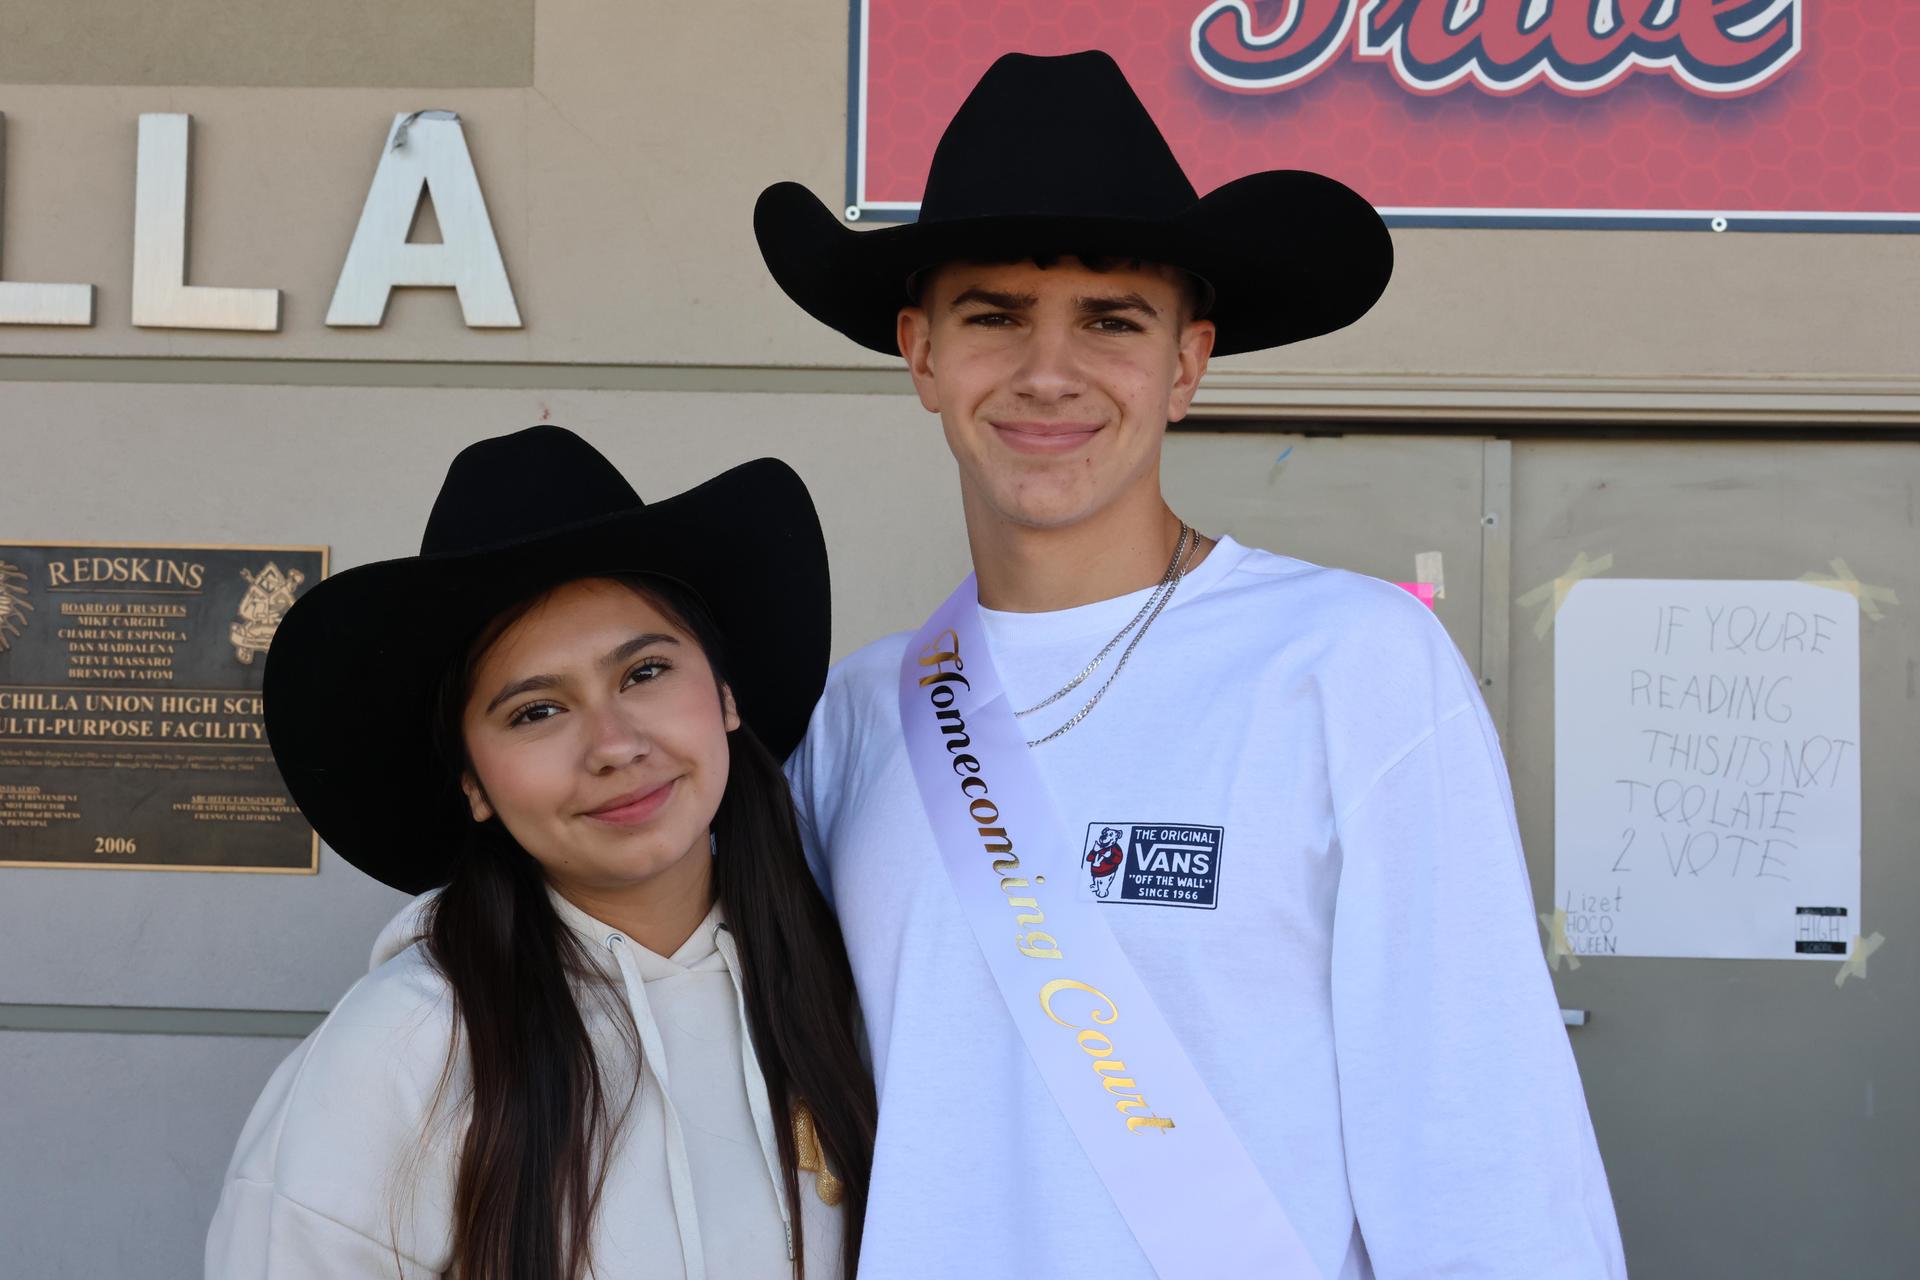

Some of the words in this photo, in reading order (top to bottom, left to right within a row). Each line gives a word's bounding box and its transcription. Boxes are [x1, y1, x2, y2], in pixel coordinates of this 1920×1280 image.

[48, 557, 205, 589] REDSKINS
[61, 603, 103, 615] BOARD
[106, 604, 121, 614] OF
[127, 604, 187, 616] TRUSTEES
[78, 616, 109, 626] MIKE
[113, 617, 167, 628] CARGILL
[1654, 605, 1691, 656] IF
[58, 629, 123, 639] CHARLENE
[127, 631, 187, 641] ESPINOLA
[69, 642, 94, 652] DAN
[71, 655, 109, 665] STEVE
[68, 669, 126, 679] BRENTON
[85, 695, 154, 712] UNION
[161, 697, 217, 714] HIGH
[1631, 669, 1793, 724] READING
[161, 720, 265, 739] FACILITY
[1136, 829, 1157, 840] THE
[1160, 830, 1215, 844] ORIGINAL
[94, 837, 137, 854] 2006
[1135, 843, 1213, 875] VANS
[1612, 828, 1636, 872] 2
[1661, 831, 1798, 882] VOTE
[918, 627, 1064, 961] Homecoming
[1039, 978, 1177, 1137] Court
[1155, 876, 1174, 887] THE
[1138, 887, 1169, 898] SINCE
[1173, 889, 1199, 900] 1966
[1566, 915, 1614, 934] HOCO
